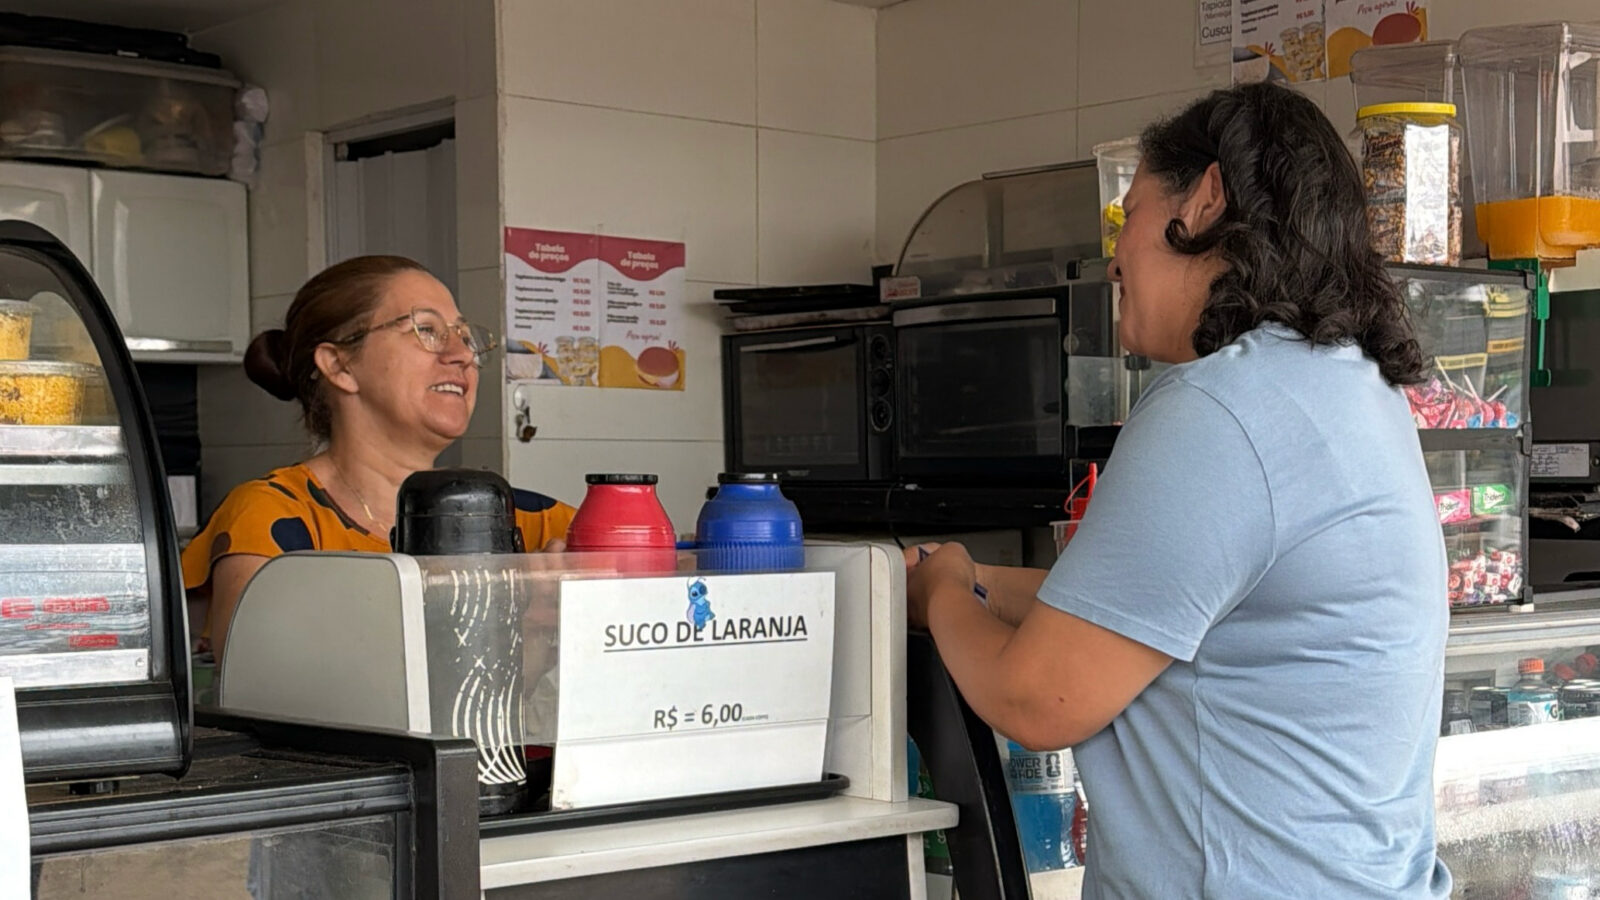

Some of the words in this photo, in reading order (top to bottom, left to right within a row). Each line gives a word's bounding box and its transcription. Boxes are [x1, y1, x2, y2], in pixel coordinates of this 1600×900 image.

[1201, 24, 1232, 39] Cuscu
[535, 242, 565, 253] Tabela
[528, 250, 540, 260] de
[540, 251, 570, 264] preços
[627, 251, 656, 261] Tabela
[620, 258, 631, 268] de
[631, 259, 659, 272] preços
[604, 623, 668, 647] SUCO
[676, 620, 705, 643] DE
[711, 615, 808, 641] LARANJA
[653, 705, 678, 730] R$
[700, 702, 743, 728] 6,00
[1010, 757, 1041, 769] OWER
